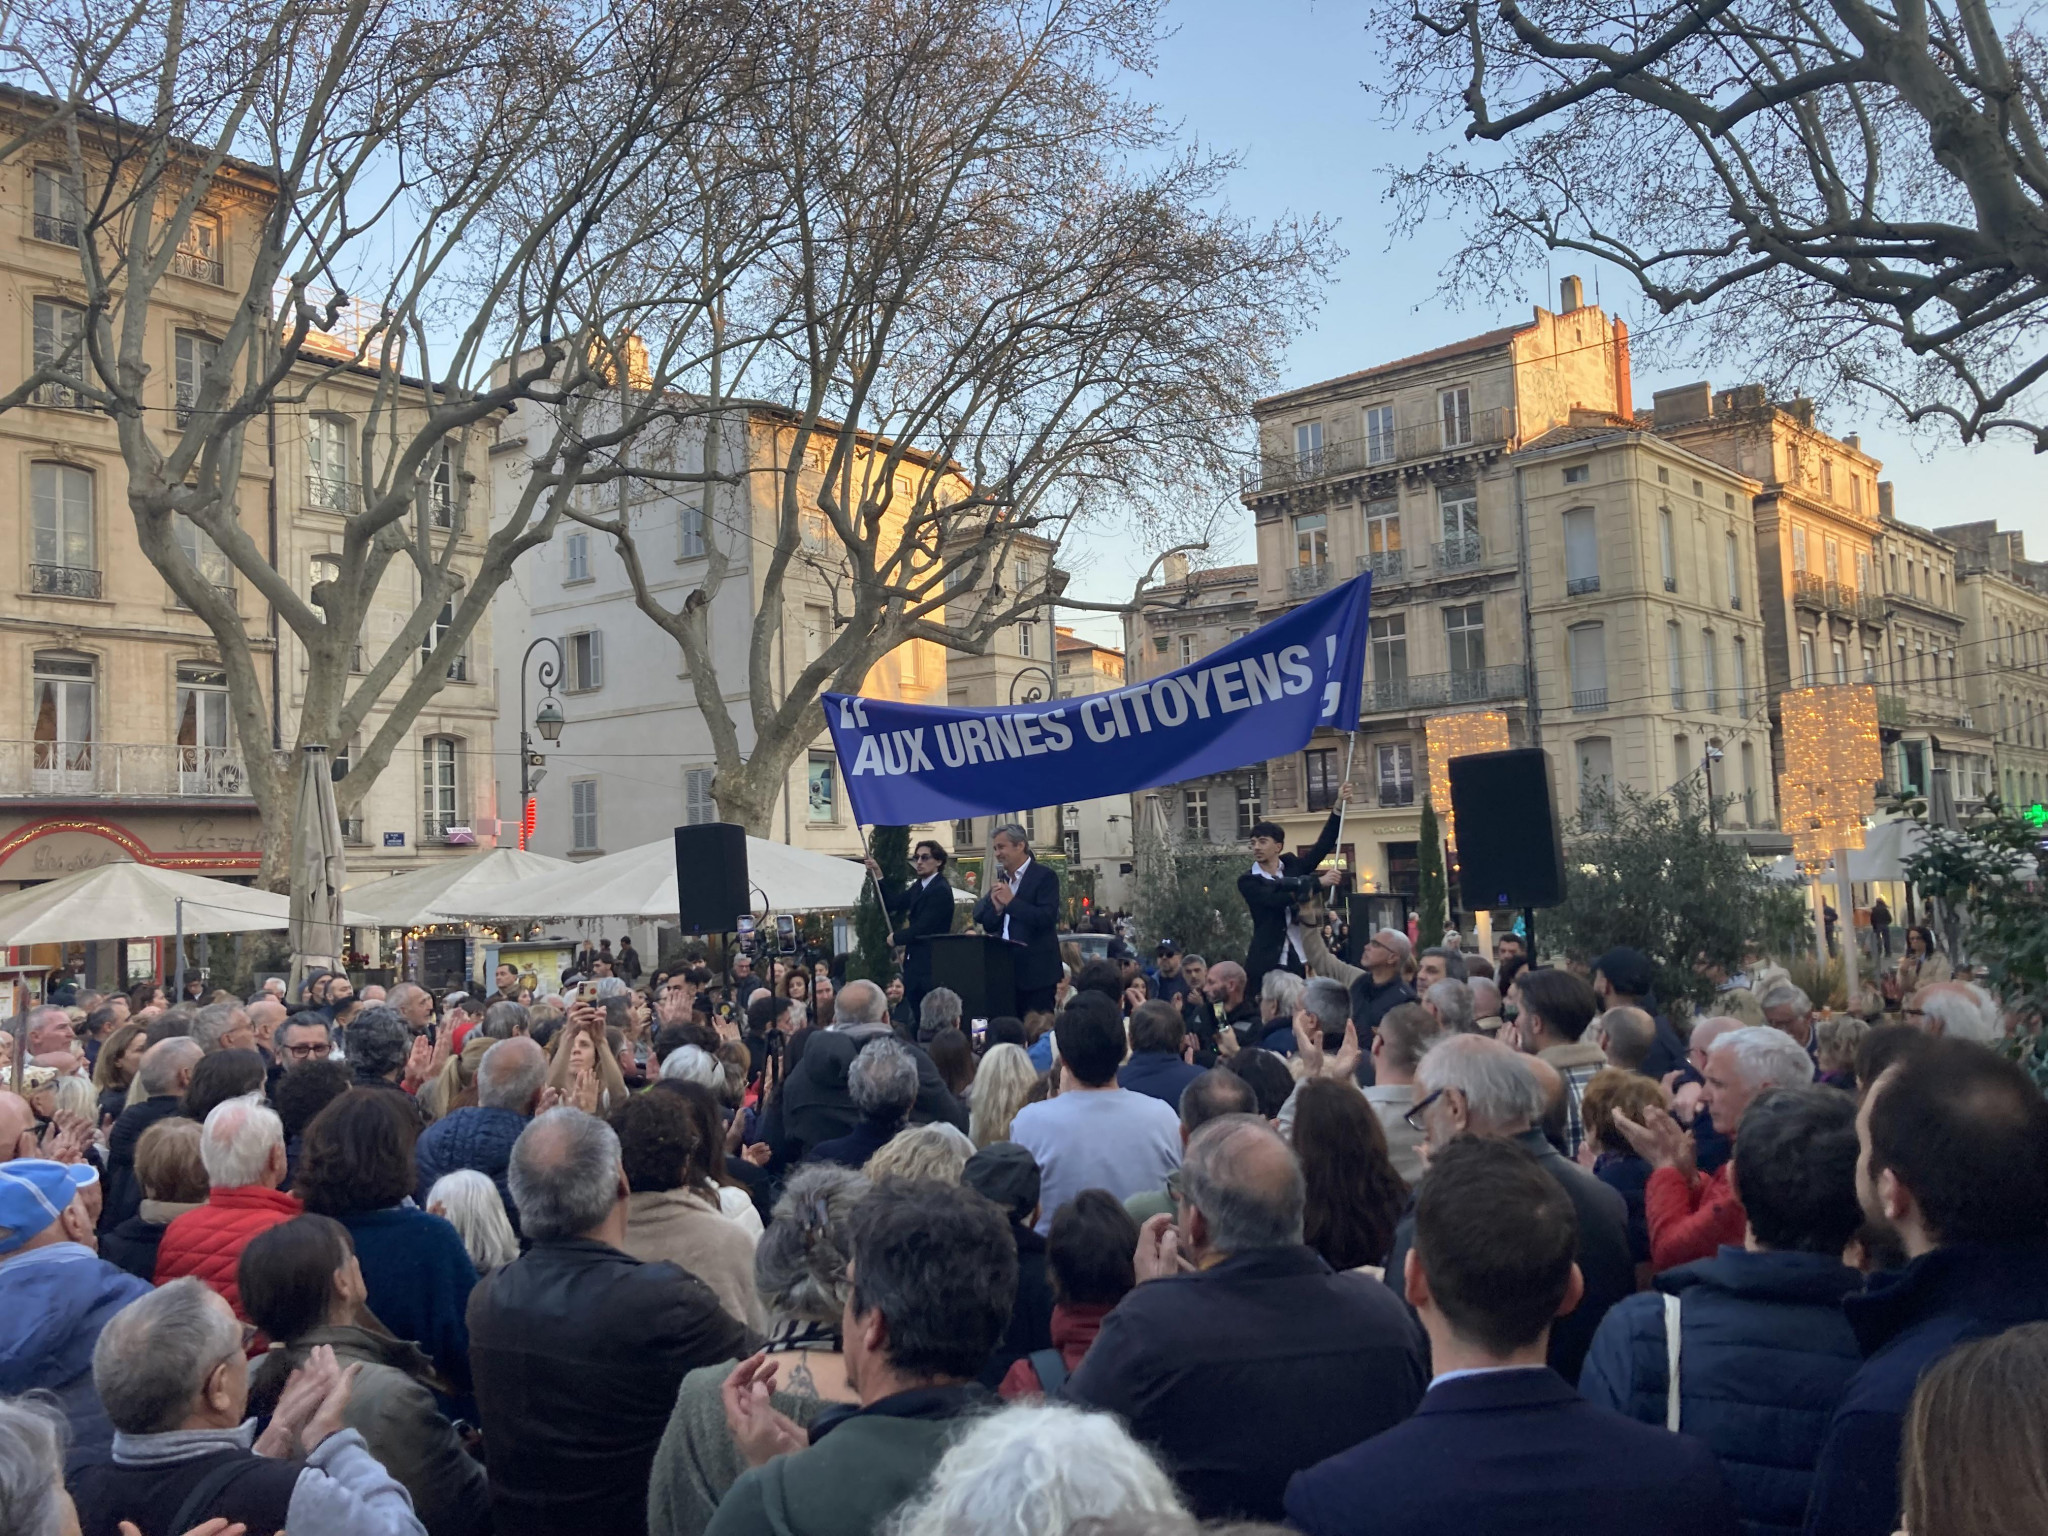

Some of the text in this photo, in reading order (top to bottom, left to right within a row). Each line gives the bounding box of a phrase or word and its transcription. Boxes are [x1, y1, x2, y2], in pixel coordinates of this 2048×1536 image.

[852, 727, 935, 776] AUX
[935, 708, 1074, 768] URNES
[1080, 644, 1313, 743] CITOYENS
